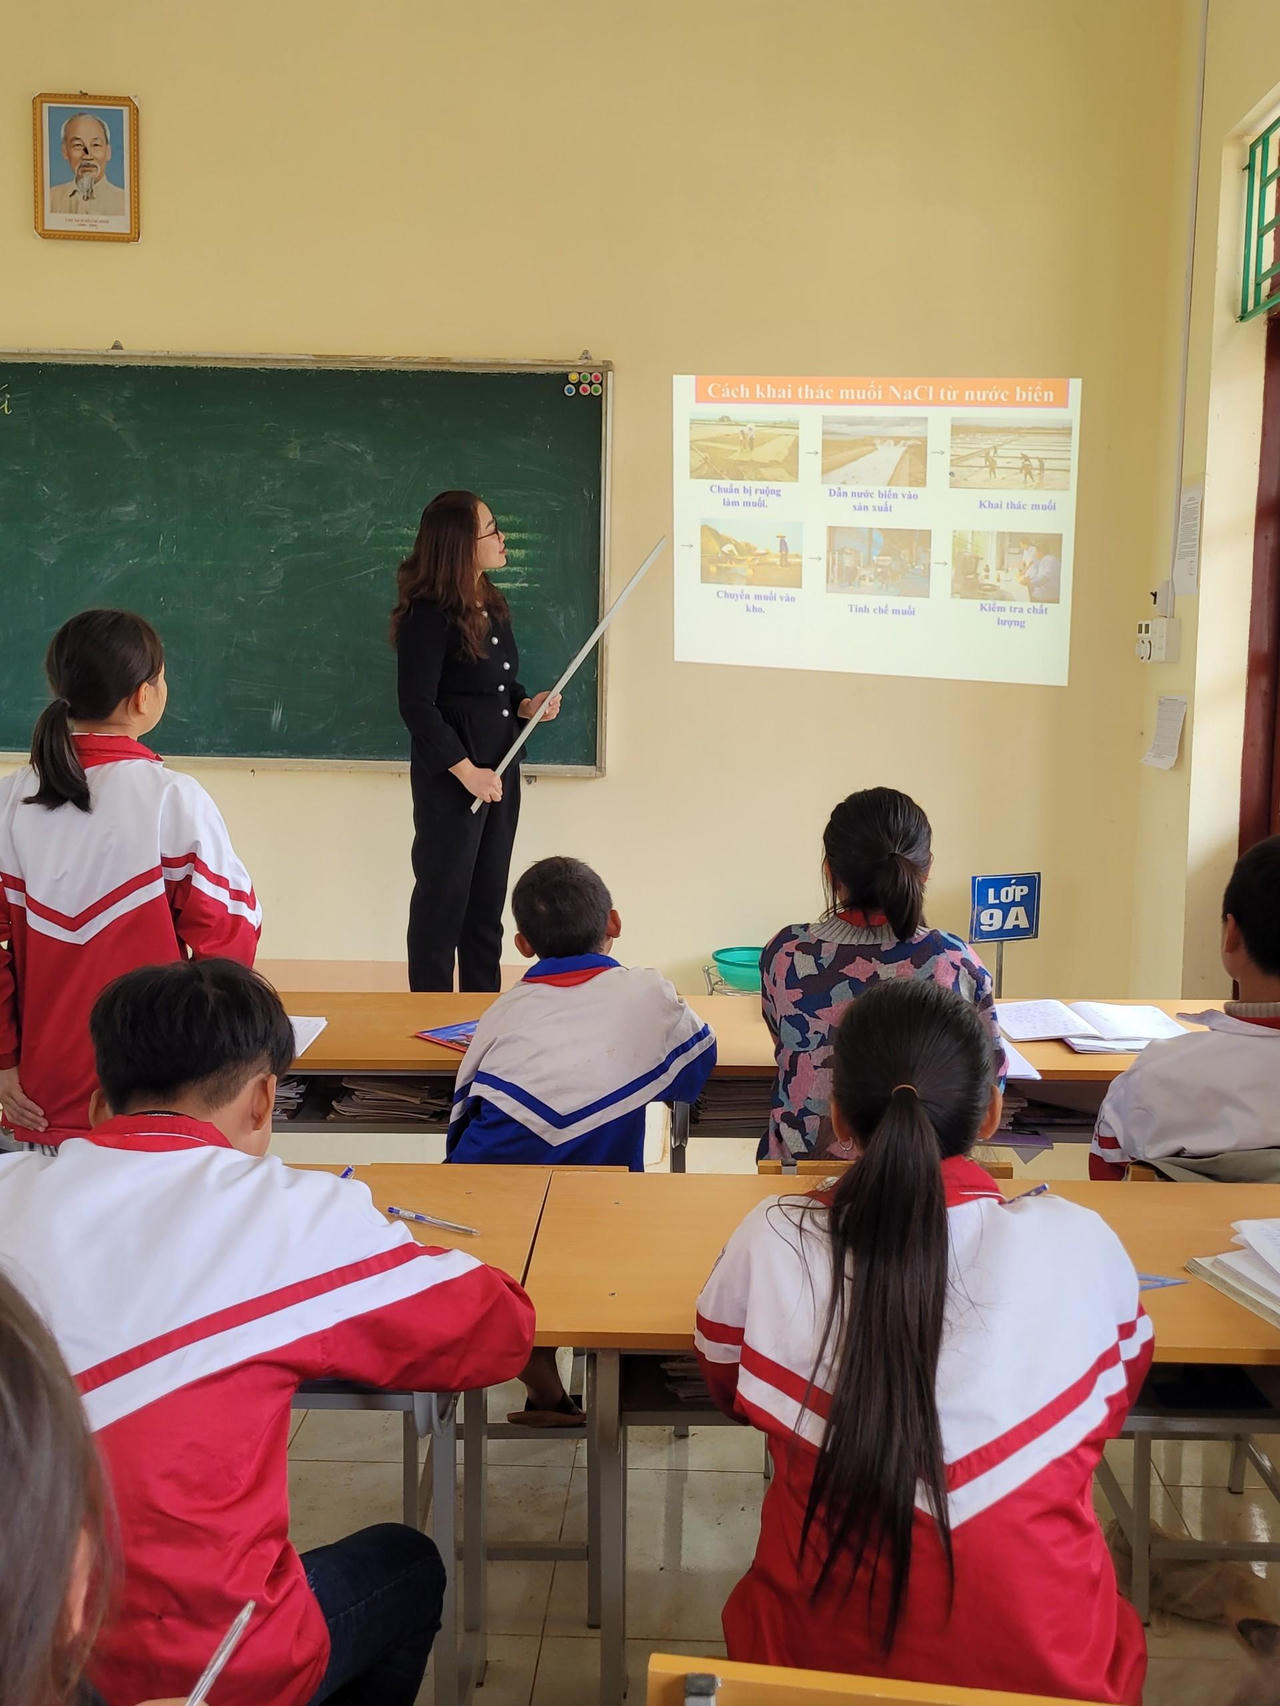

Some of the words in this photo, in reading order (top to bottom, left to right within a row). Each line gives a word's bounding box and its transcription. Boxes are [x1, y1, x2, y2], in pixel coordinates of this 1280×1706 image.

[707, 382, 750, 400] Cách
[755, 383, 793, 400] khai
[798, 384, 833, 400] thác
[839, 380, 883, 401] muối
[889, 385, 934, 401] NaCl
[939, 385, 960, 401] từ
[964, 386, 1009, 402] nước
[754, 486, 781, 497] ruộng
[851, 489, 874, 498] nước
[901, 490, 918, 500] vào
[722, 498, 740, 507] làm
[979, 500, 1003, 509] Khai
[1006, 501, 1027, 510] thác
[1031, 499, 1056, 511] muối
[754, 590, 777, 602] muối
[779, 594, 796, 602] vào
[745, 604, 766, 614] kho.
[873, 603, 889, 615] chế
[892, 604, 916, 616] muối
[1009, 605, 1024, 614] tra
[1027, 604, 1048, 615] chất
[997, 617, 1026, 629] lượng
[980, 906, 1030, 932] 9A
